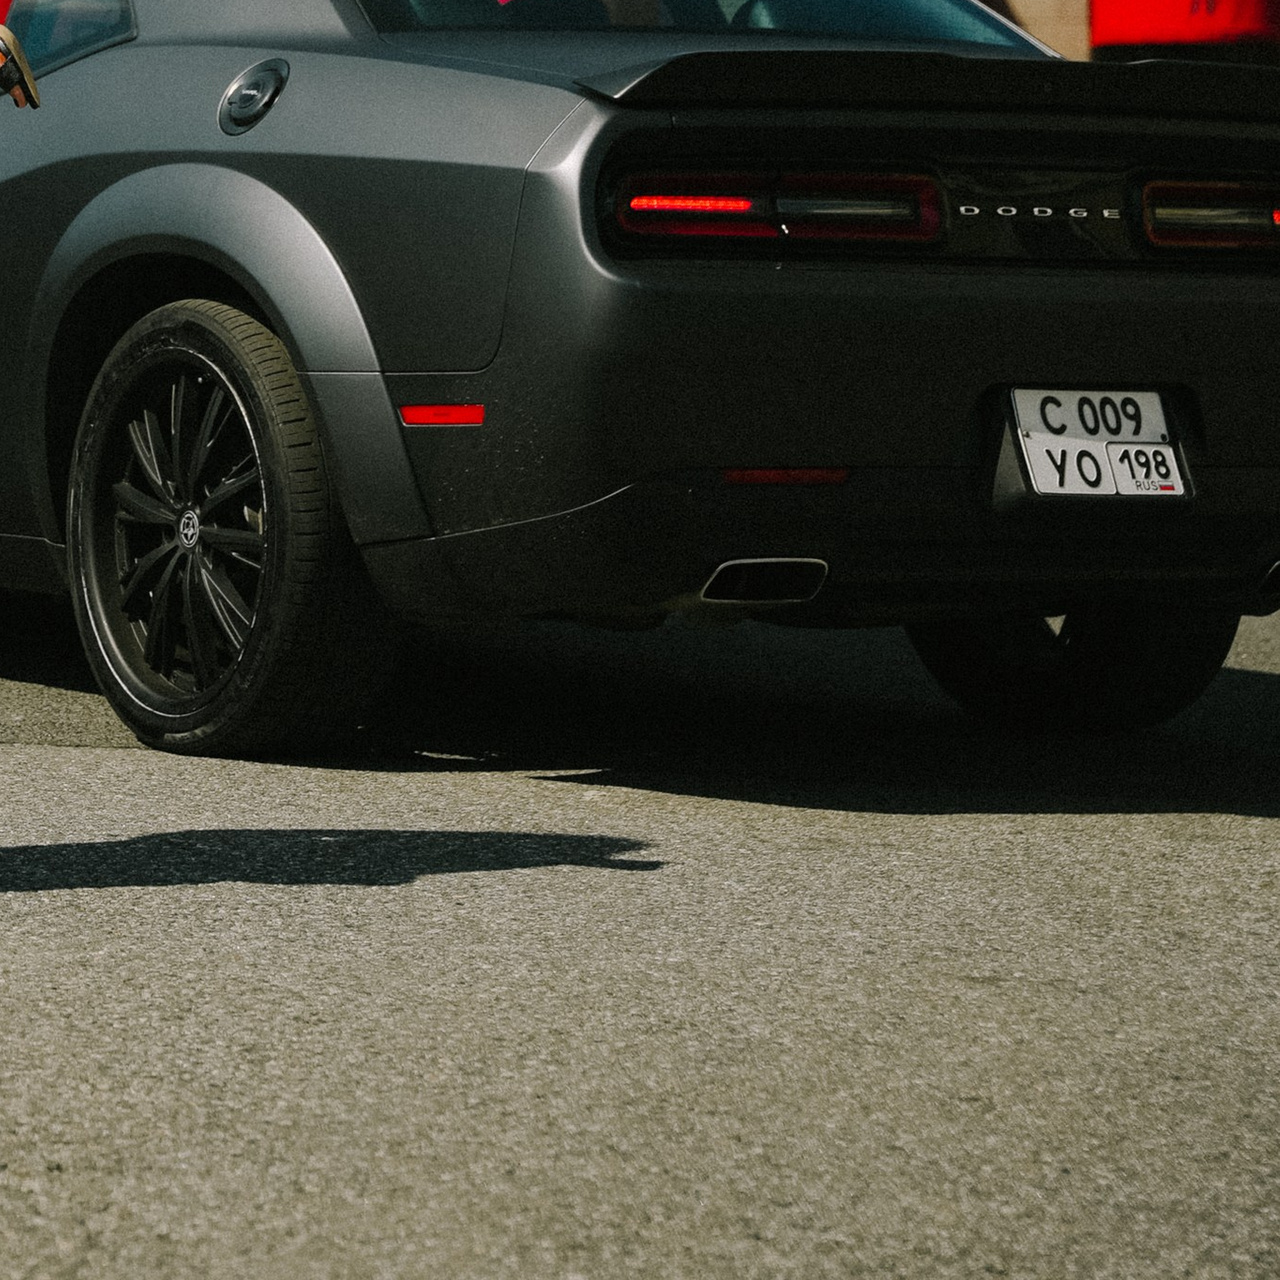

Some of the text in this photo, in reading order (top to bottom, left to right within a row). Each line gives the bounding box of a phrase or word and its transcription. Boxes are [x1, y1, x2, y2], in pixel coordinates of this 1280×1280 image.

[959, 205, 1120, 218] DODGE
[1040, 395, 1142, 436] С 009
[1119, 449, 1170, 480] 198
[1136, 480, 1158, 491] RUS
